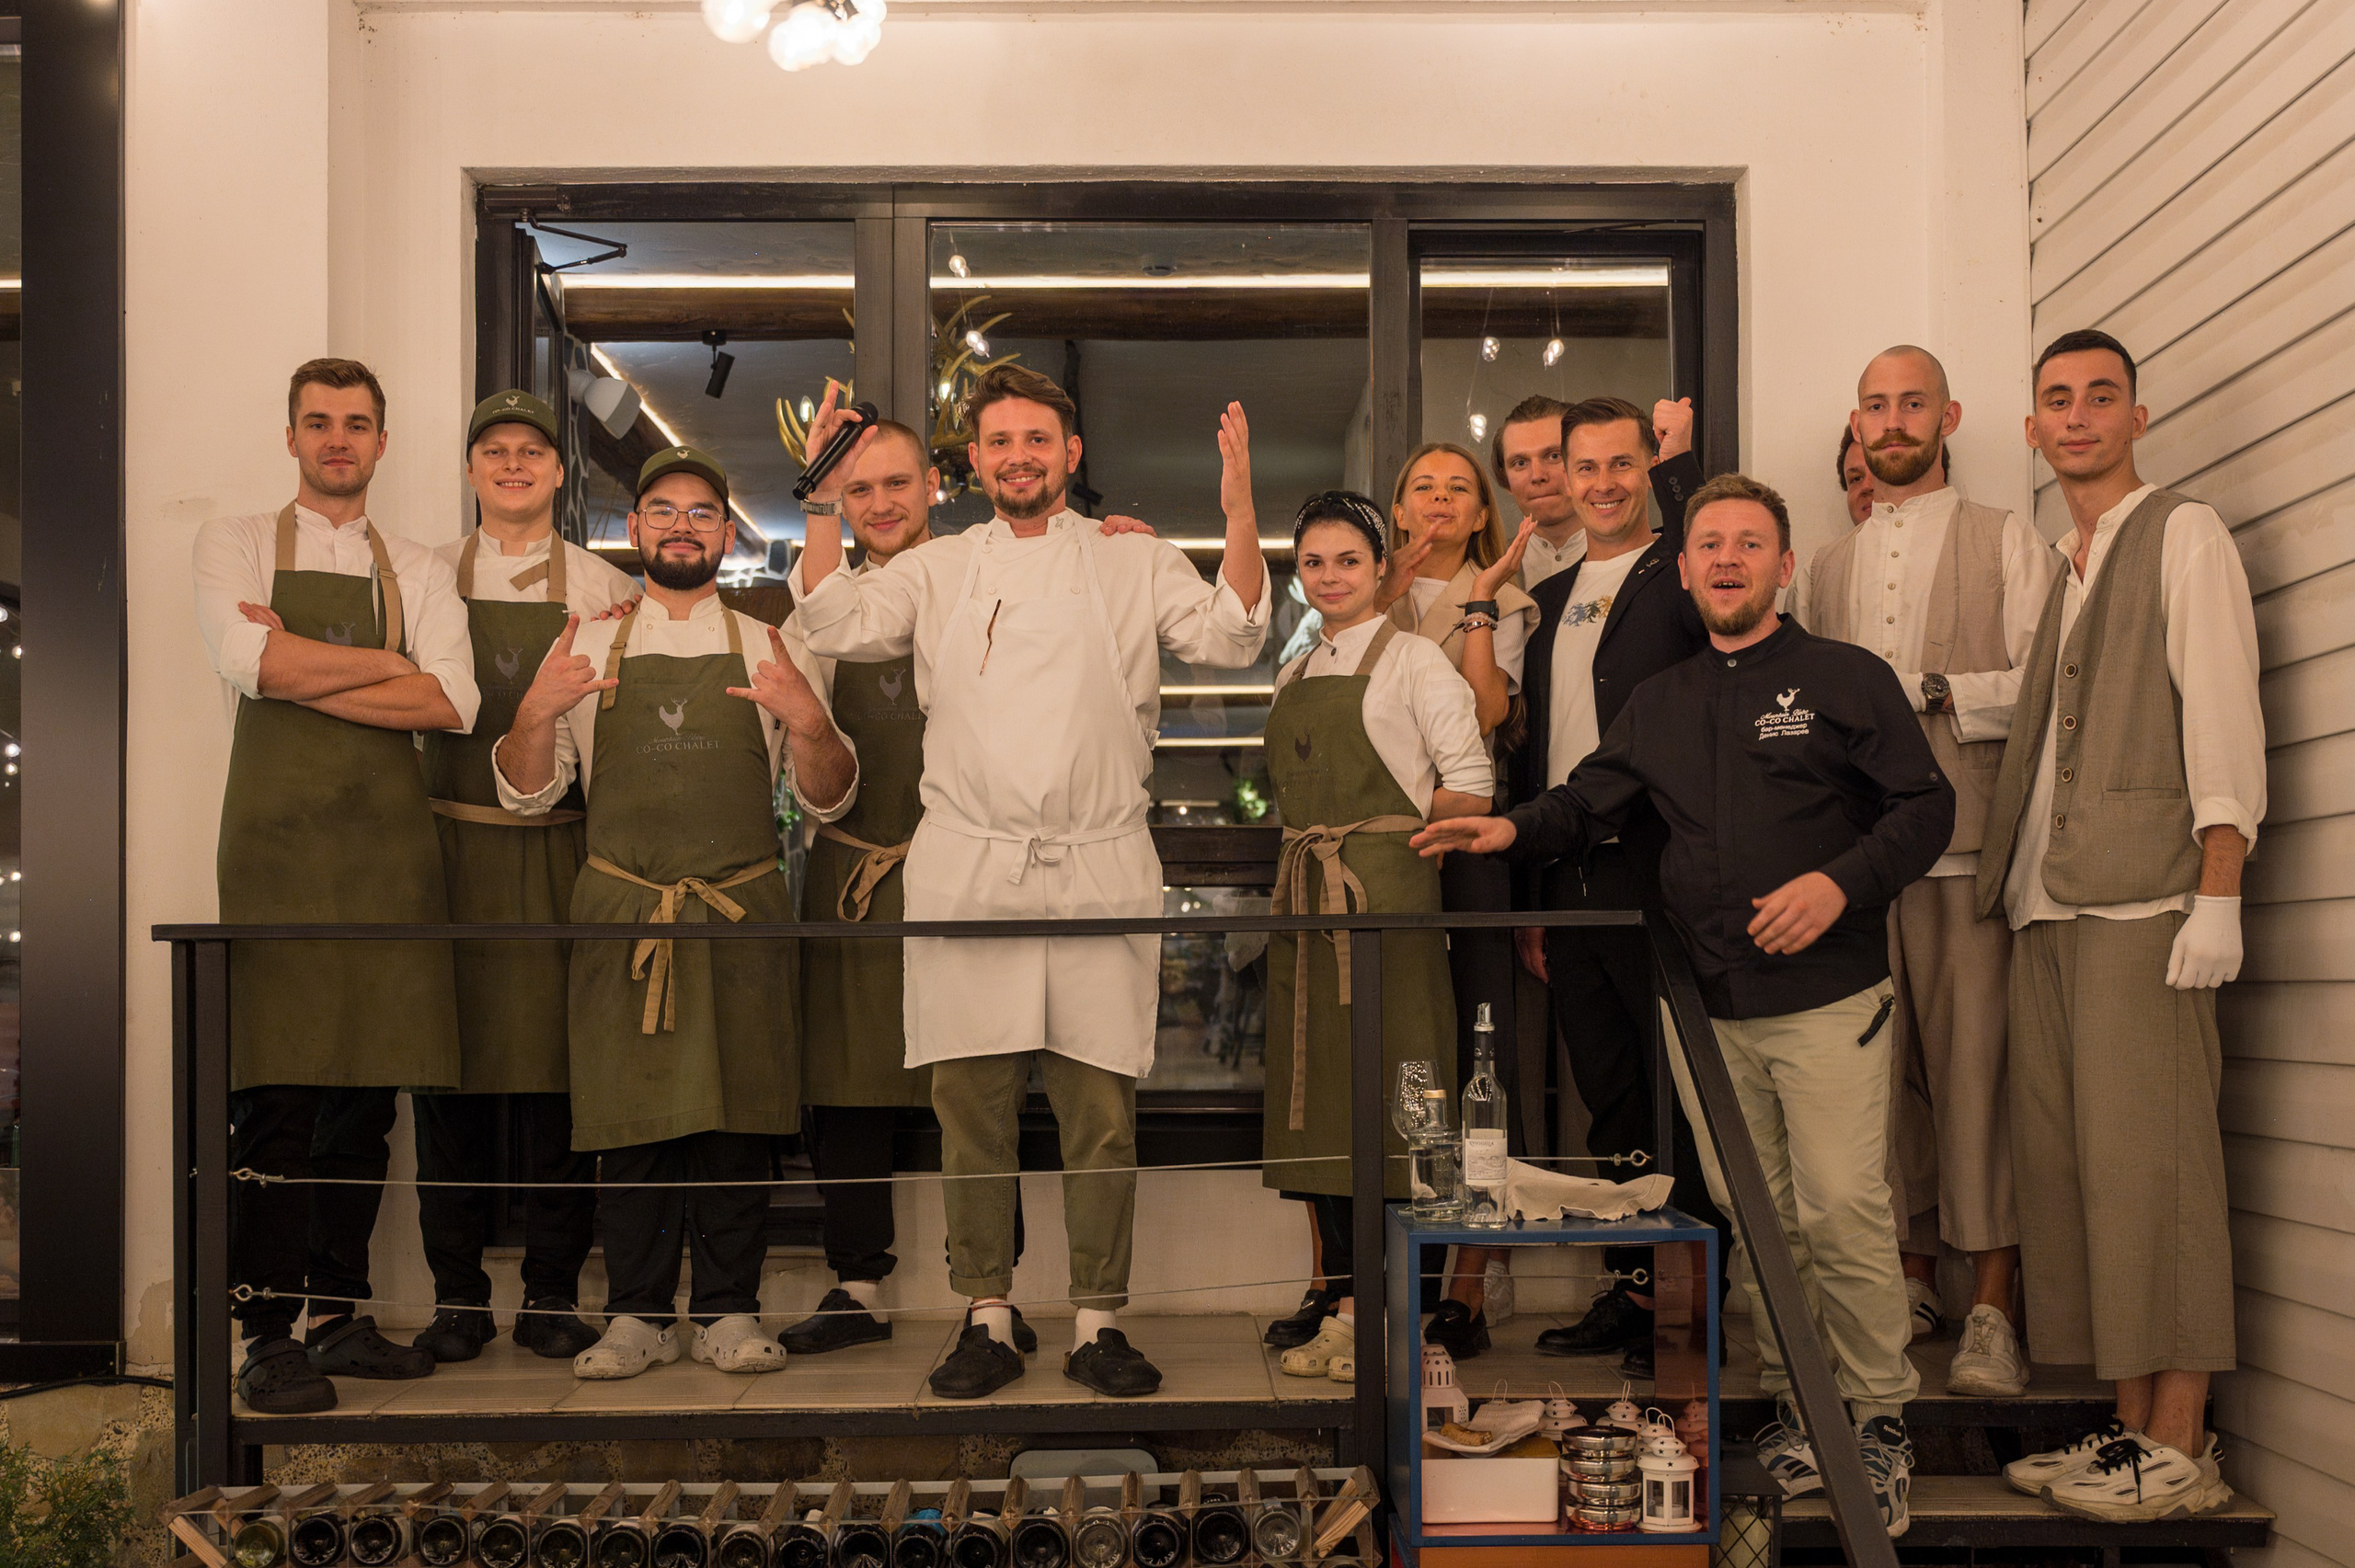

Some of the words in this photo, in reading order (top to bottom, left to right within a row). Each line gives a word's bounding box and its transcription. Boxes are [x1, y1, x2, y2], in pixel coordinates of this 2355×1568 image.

[1754, 717, 1782, 727] CO-CO
[1782, 713, 1815, 723] CHALET
[1780, 728, 1809, 737] Лазарев
[636, 742, 672, 755] CO-CO
[674, 740, 720, 750] CHALET
